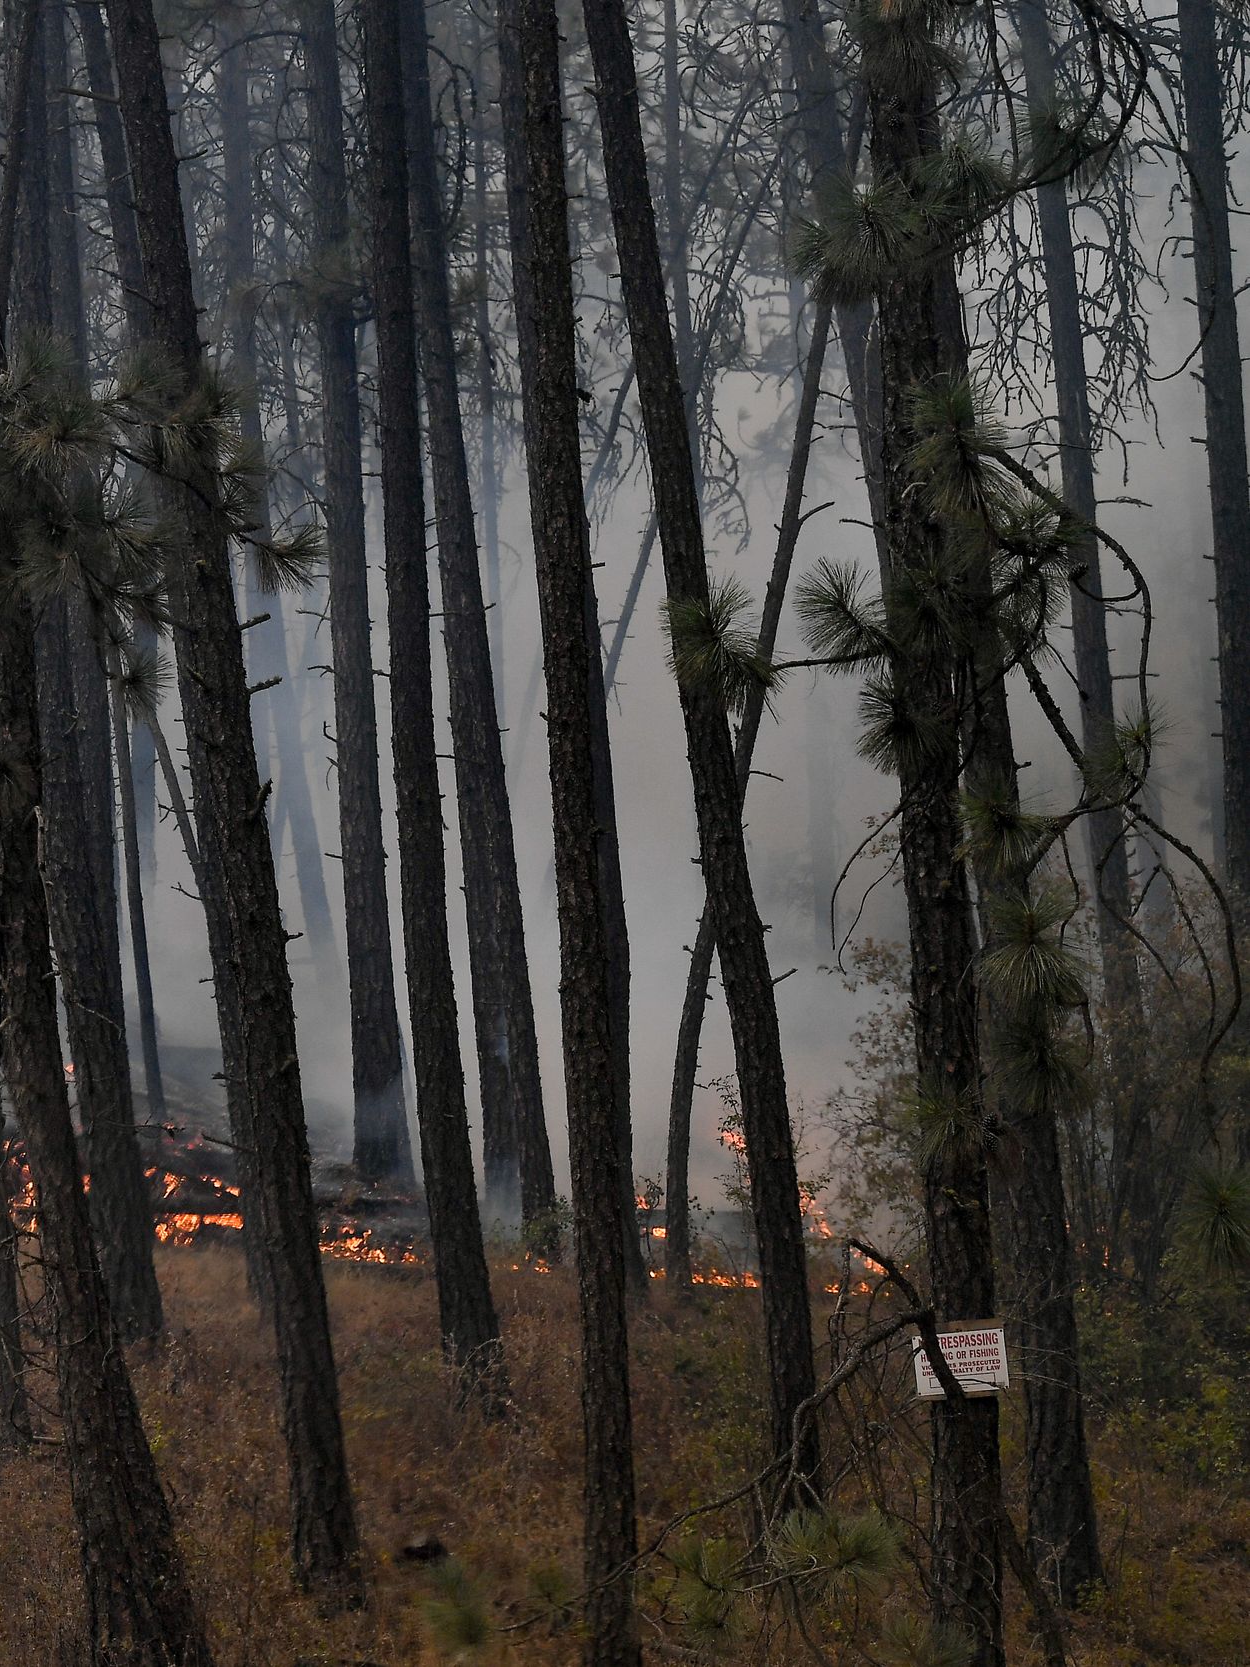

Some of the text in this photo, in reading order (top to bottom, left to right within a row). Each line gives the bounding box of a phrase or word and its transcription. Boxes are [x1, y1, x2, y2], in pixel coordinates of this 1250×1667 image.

[938, 1333, 998, 1349] RESPASSING
[956, 1350, 967, 1360] OR
[969, 1348, 999, 1358] FISHING
[958, 1359, 1001, 1368] PROSECUTED
